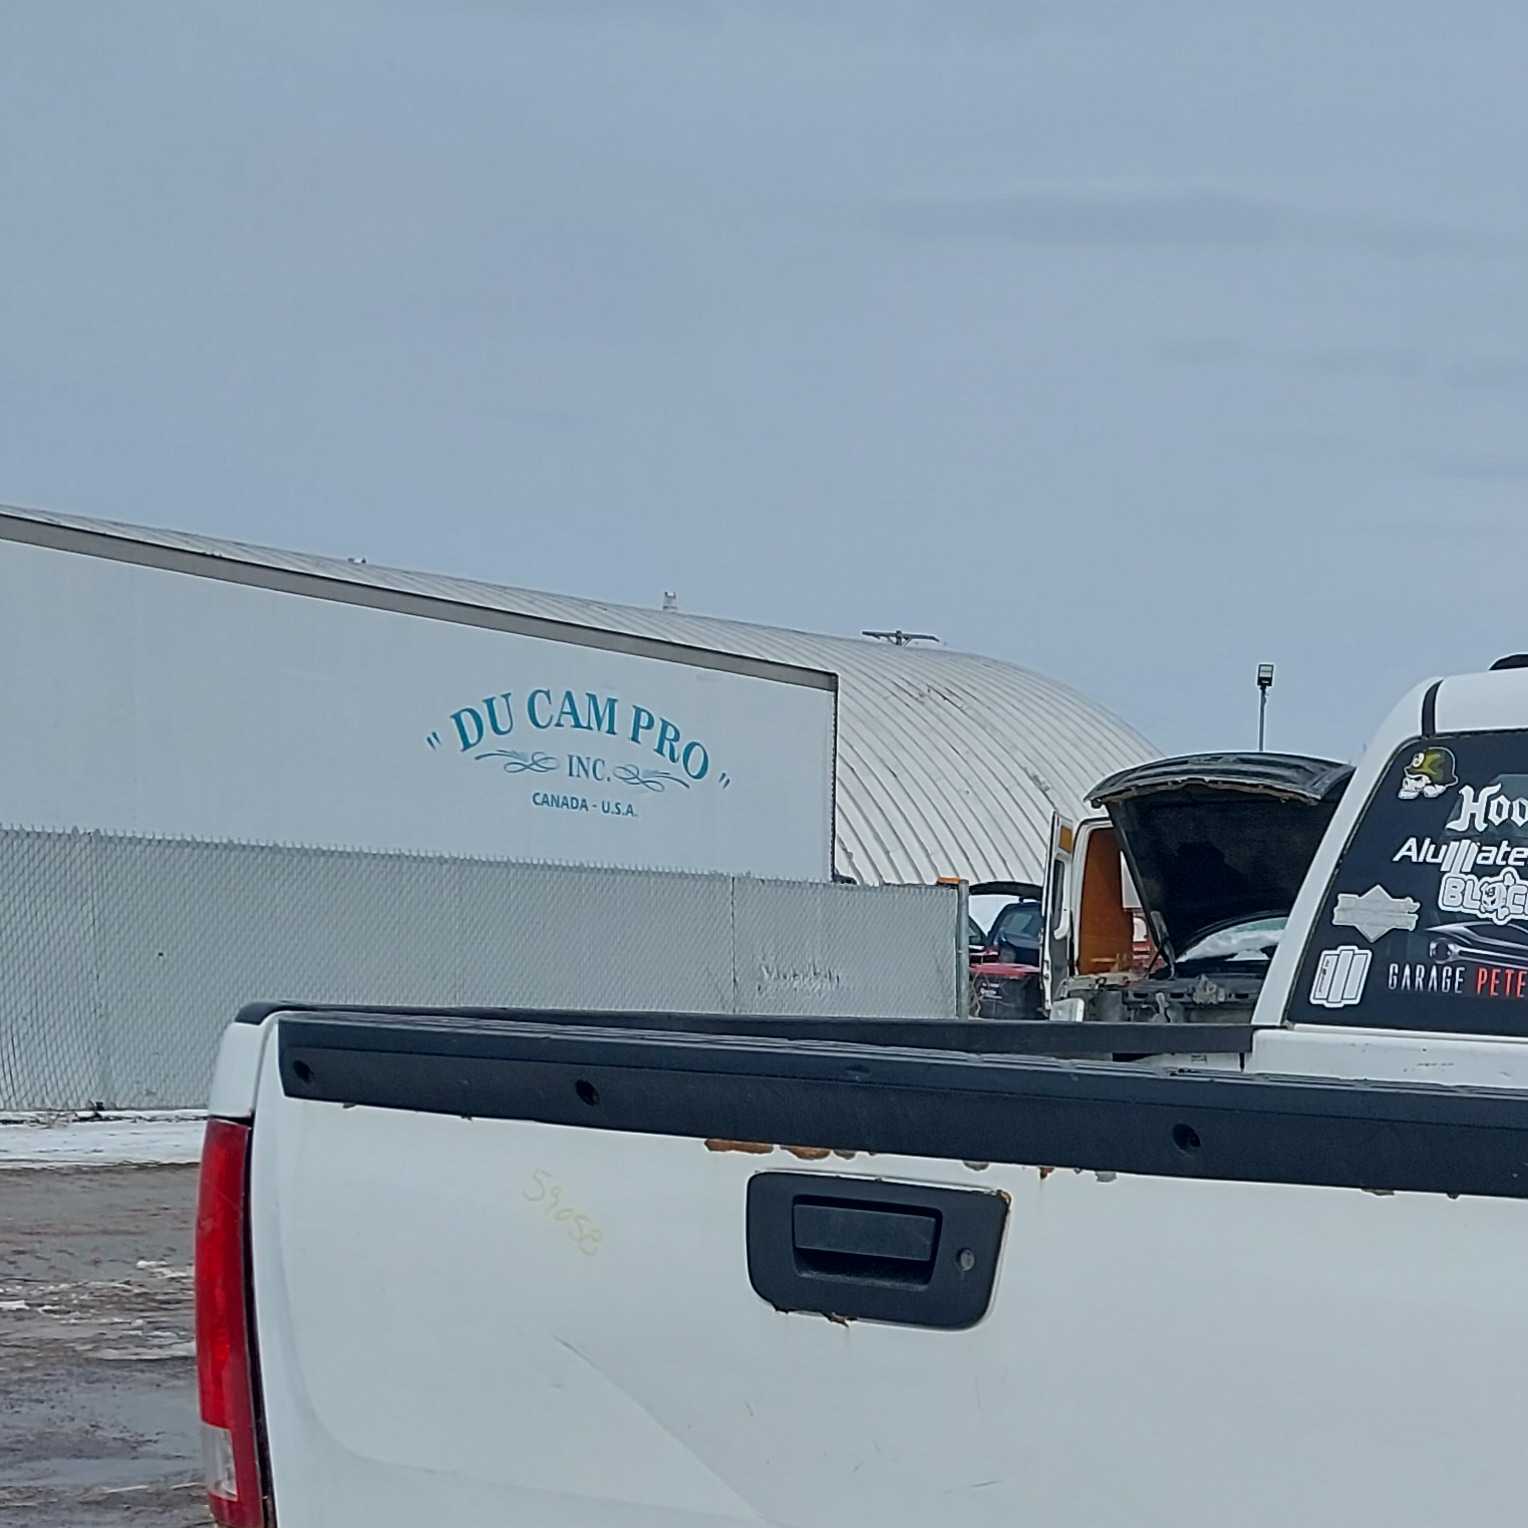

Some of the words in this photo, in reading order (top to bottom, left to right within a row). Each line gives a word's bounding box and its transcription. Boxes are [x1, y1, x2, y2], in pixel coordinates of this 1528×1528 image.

[527, 689, 619, 736] CAM
[567, 754, 612, 782] INC.
[532, 792, 589, 812] CANADA
[601, 800, 638, 817] U.S.A.
[1388, 963, 1465, 994] GARAGE
[1476, 967, 1527, 998] PETE
